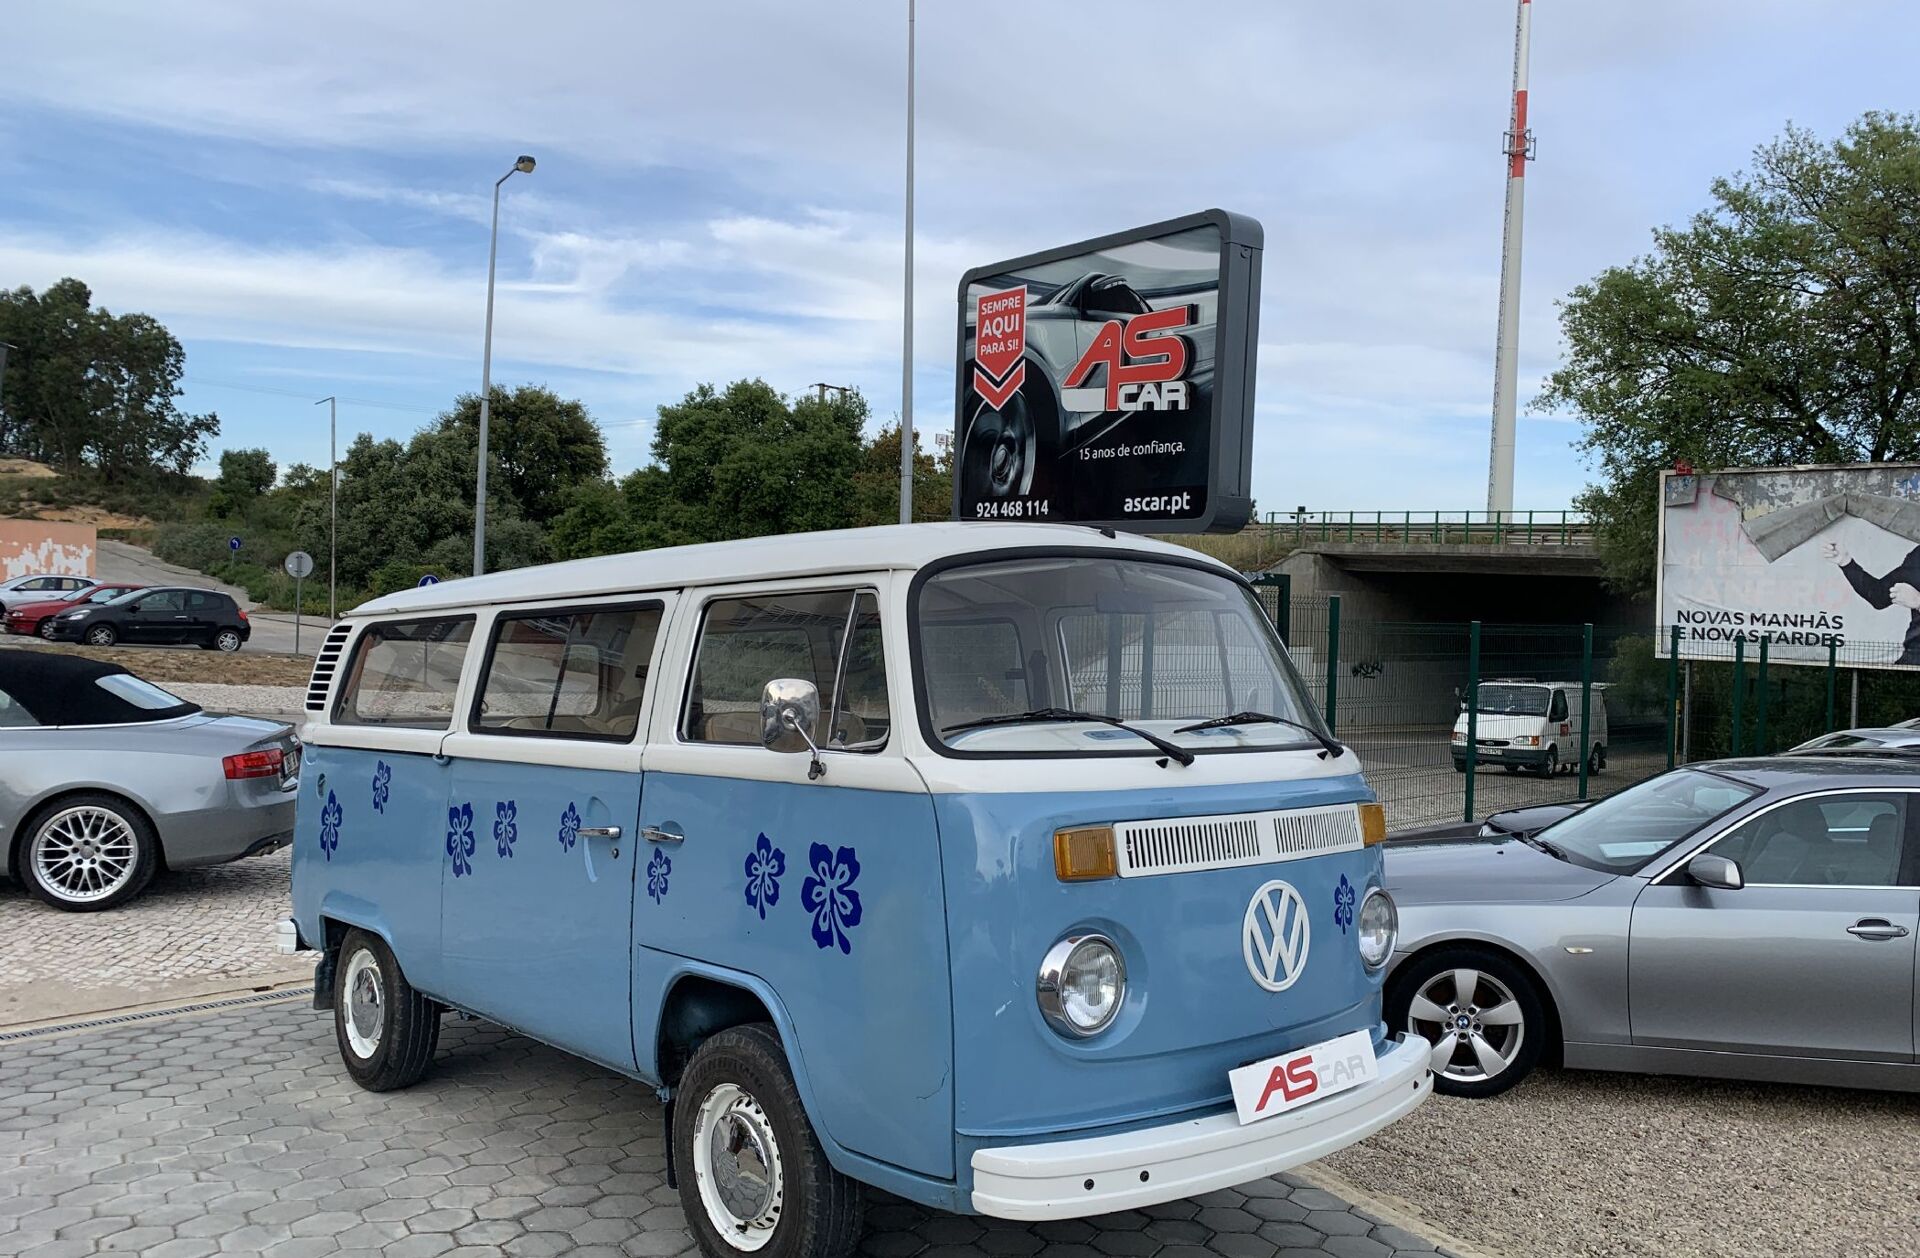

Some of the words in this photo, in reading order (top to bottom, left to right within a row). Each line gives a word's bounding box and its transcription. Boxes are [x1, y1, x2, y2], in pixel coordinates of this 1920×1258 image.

[981, 296, 1021, 315] SEMPRE
[981, 313, 1020, 339] AQUI
[980, 341, 1005, 356] PARA
[1007, 338, 1019, 351] SI!
[1118, 381, 1190, 411] CAR
[1079, 448, 1090, 460] 15
[1092, 448, 1115, 459] anos
[1117, 443, 1130, 457] de
[1132, 440, 1186, 456] confiança.
[976, 501, 998, 518] 924
[1000, 500, 1023, 517] 468
[1026, 499, 1049, 516] 114
[1123, 491, 1191, 514] ascar.pt
[1677, 610, 1745, 625] NOVAS
[1750, 611, 1844, 630] MANHÃS
[1678, 626, 1687, 640] E
[1691, 627, 1760, 643] NOVAS
[1764, 629, 1845, 648] TARDES
